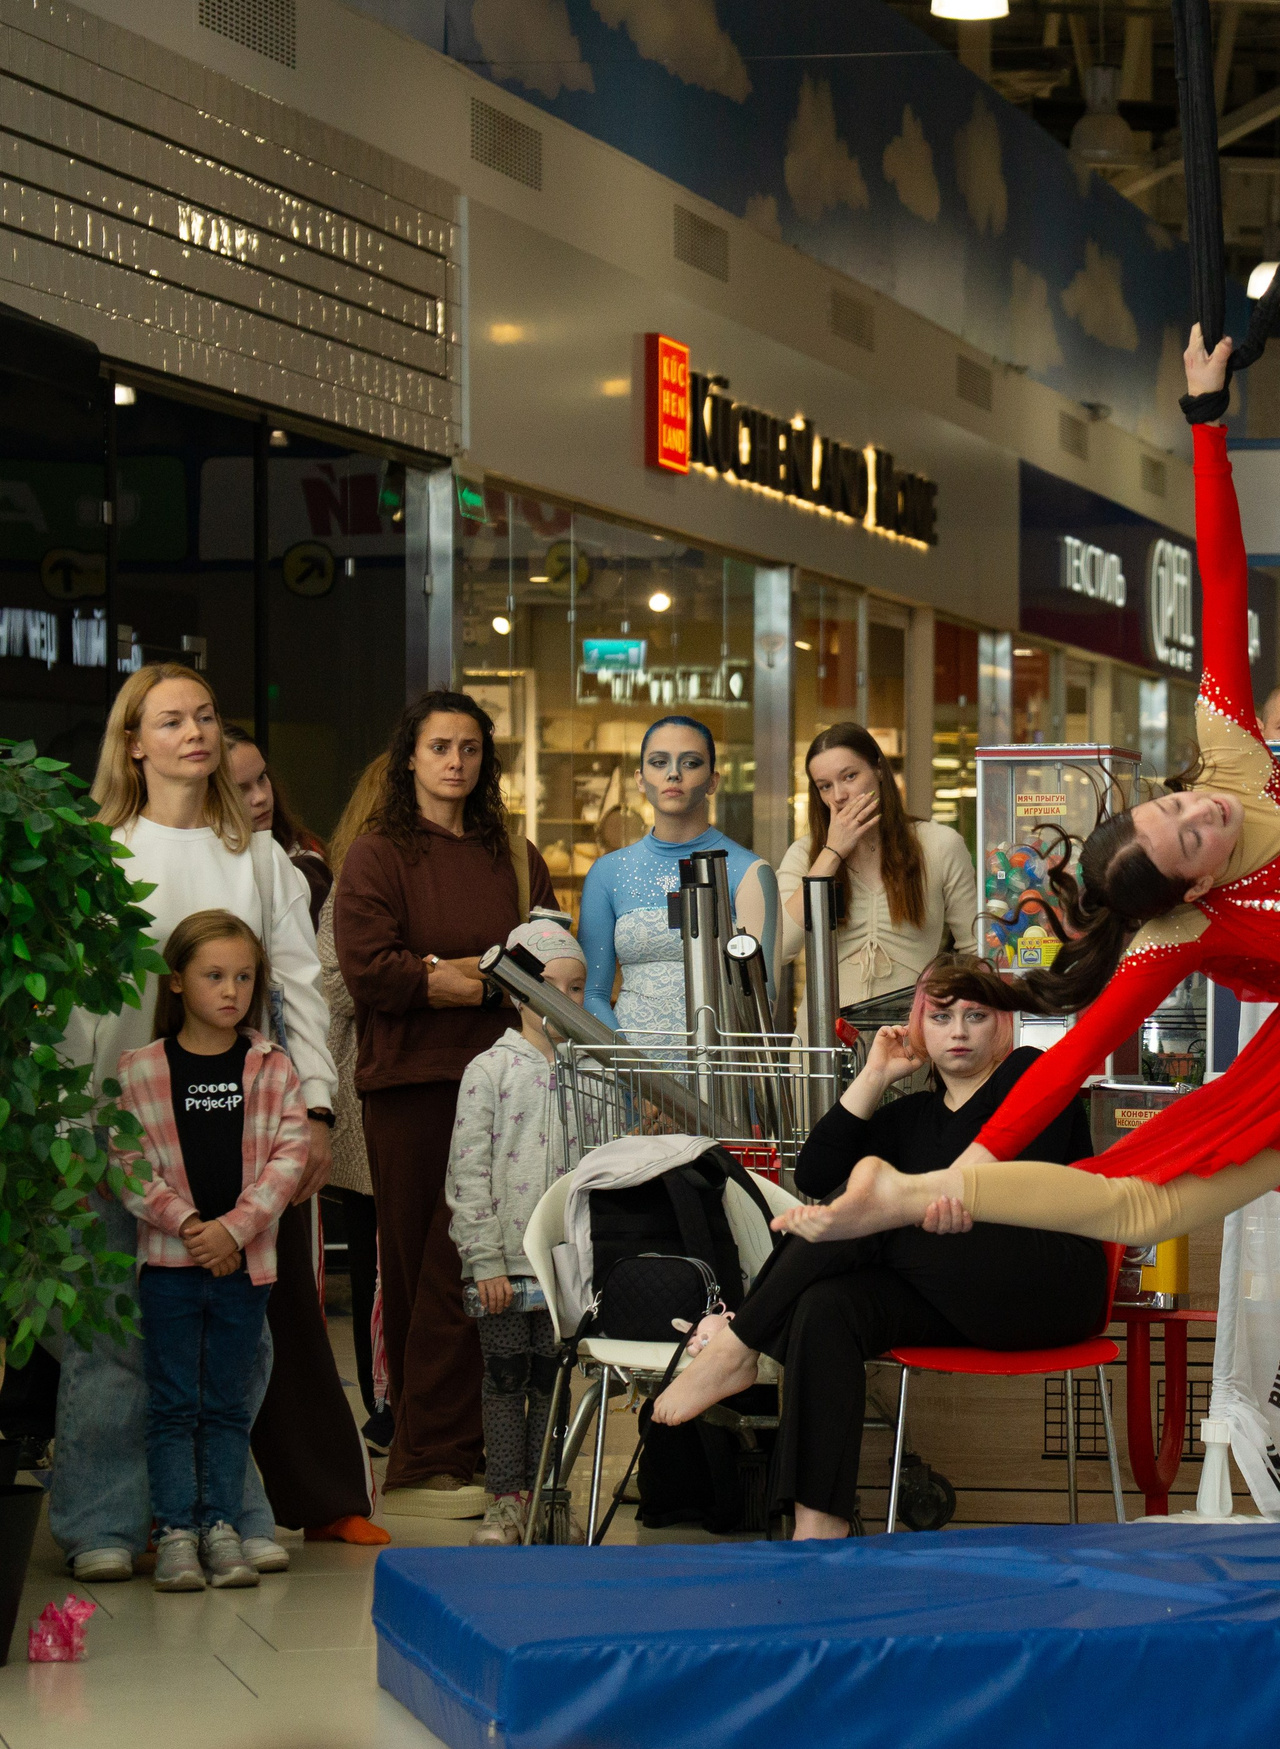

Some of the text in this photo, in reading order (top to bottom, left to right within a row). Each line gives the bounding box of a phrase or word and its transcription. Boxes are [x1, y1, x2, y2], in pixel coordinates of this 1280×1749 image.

[662, 389, 686, 419] HEN
[661, 428, 686, 454] LAND
[1061, 535, 1127, 608] ТЕКСТИЛЬ
[1023, 807, 1061, 815] ИГРУШКА
